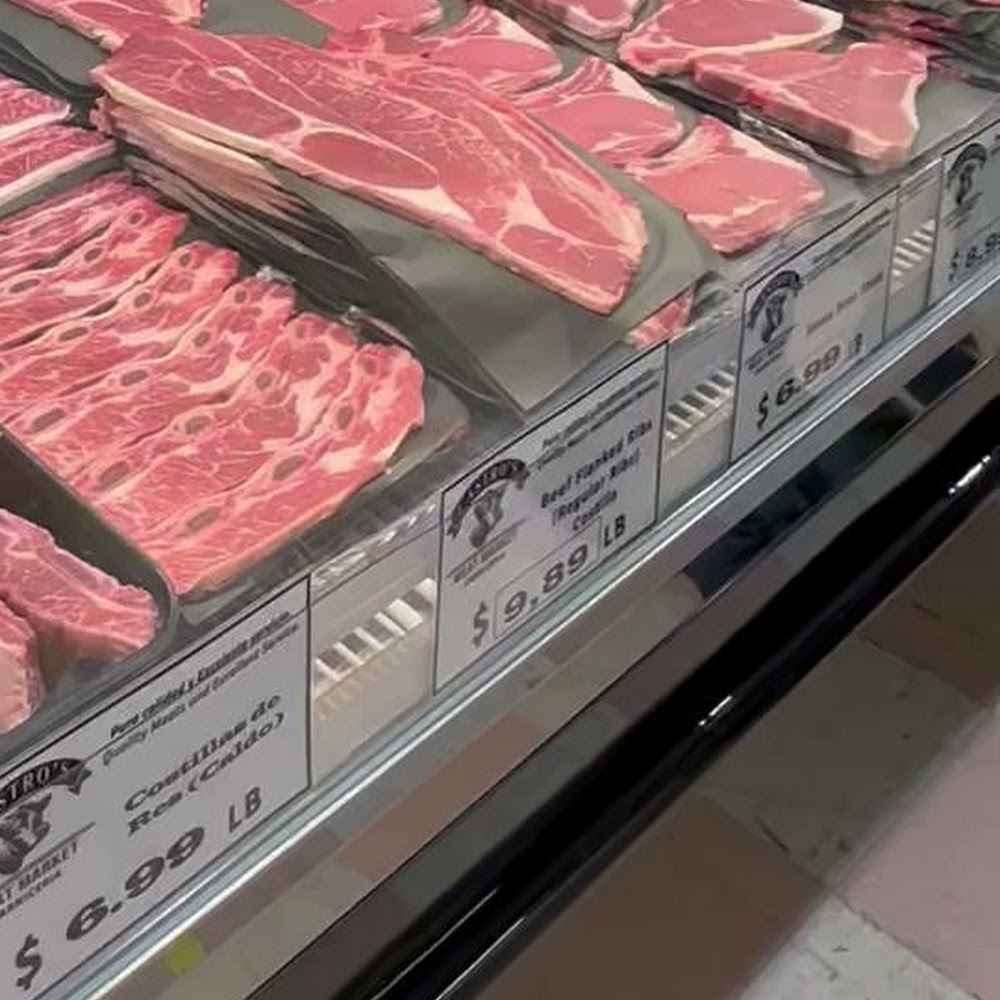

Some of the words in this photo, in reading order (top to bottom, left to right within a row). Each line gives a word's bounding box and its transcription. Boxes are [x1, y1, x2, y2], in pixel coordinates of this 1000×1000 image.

[776, 345, 841, 406] 6.99
[541, 475, 572, 508] Beef
[575, 437, 624, 485] Flanked
[473, 602, 490, 647] $
[504, 544, 589, 624] 9.89
[603, 514, 627, 550] LB
[103, 729, 148, 766] Quality
[124, 719, 247, 814] Costillas
[251, 695, 282, 723] de
[127, 788, 183, 838] Res
[186, 712, 286, 793] (Caldo)
[14, 934, 42, 990] $
[66, 826, 205, 942] 6.99
[227, 786, 262, 833] LB
[18, 841, 78, 891] MARKET
